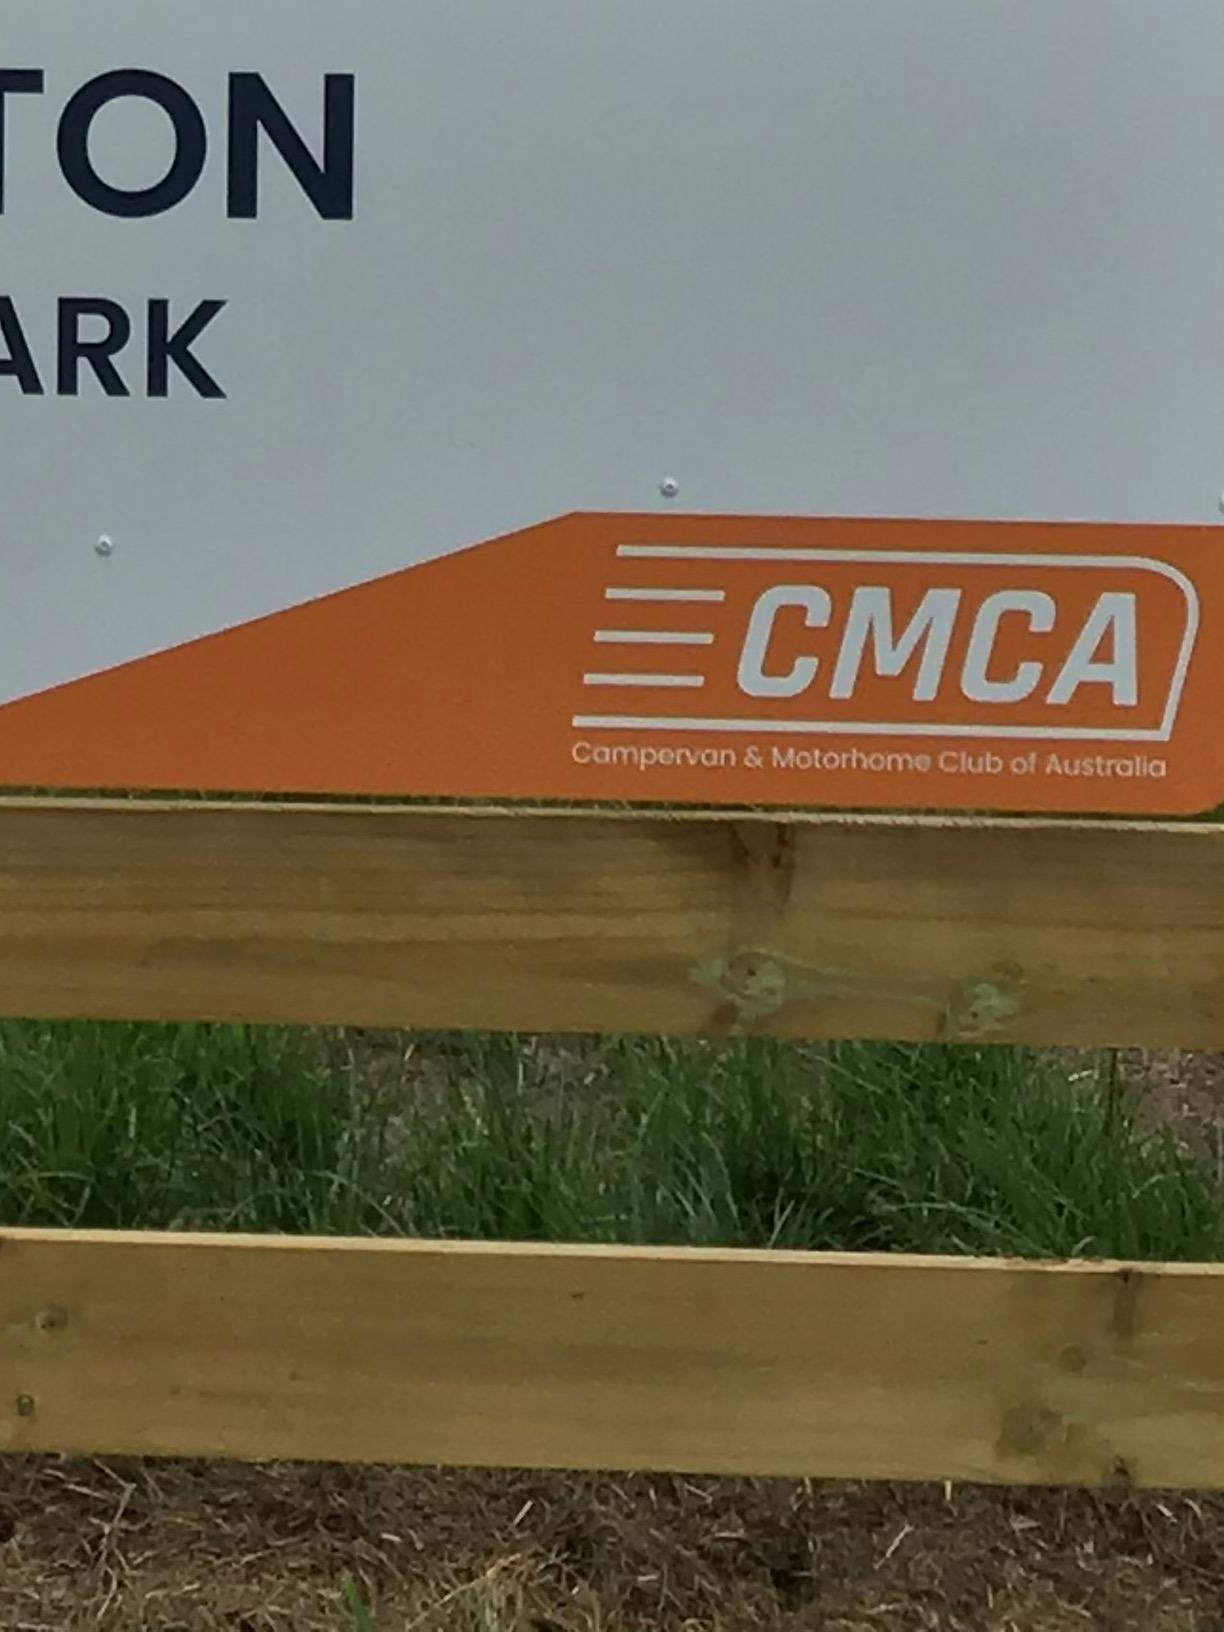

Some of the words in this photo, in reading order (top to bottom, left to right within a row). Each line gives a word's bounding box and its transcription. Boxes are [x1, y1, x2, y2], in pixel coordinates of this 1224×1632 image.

[736, 583, 1140, 707] CMCA
[571, 741, 737, 772] Campervan
[743, 745, 764, 768] &
[771, 746, 931, 772] Motorhome
[938, 751, 1004, 774] Club
[1010, 752, 1038, 775] of
[1045, 753, 1167, 778] Australia
